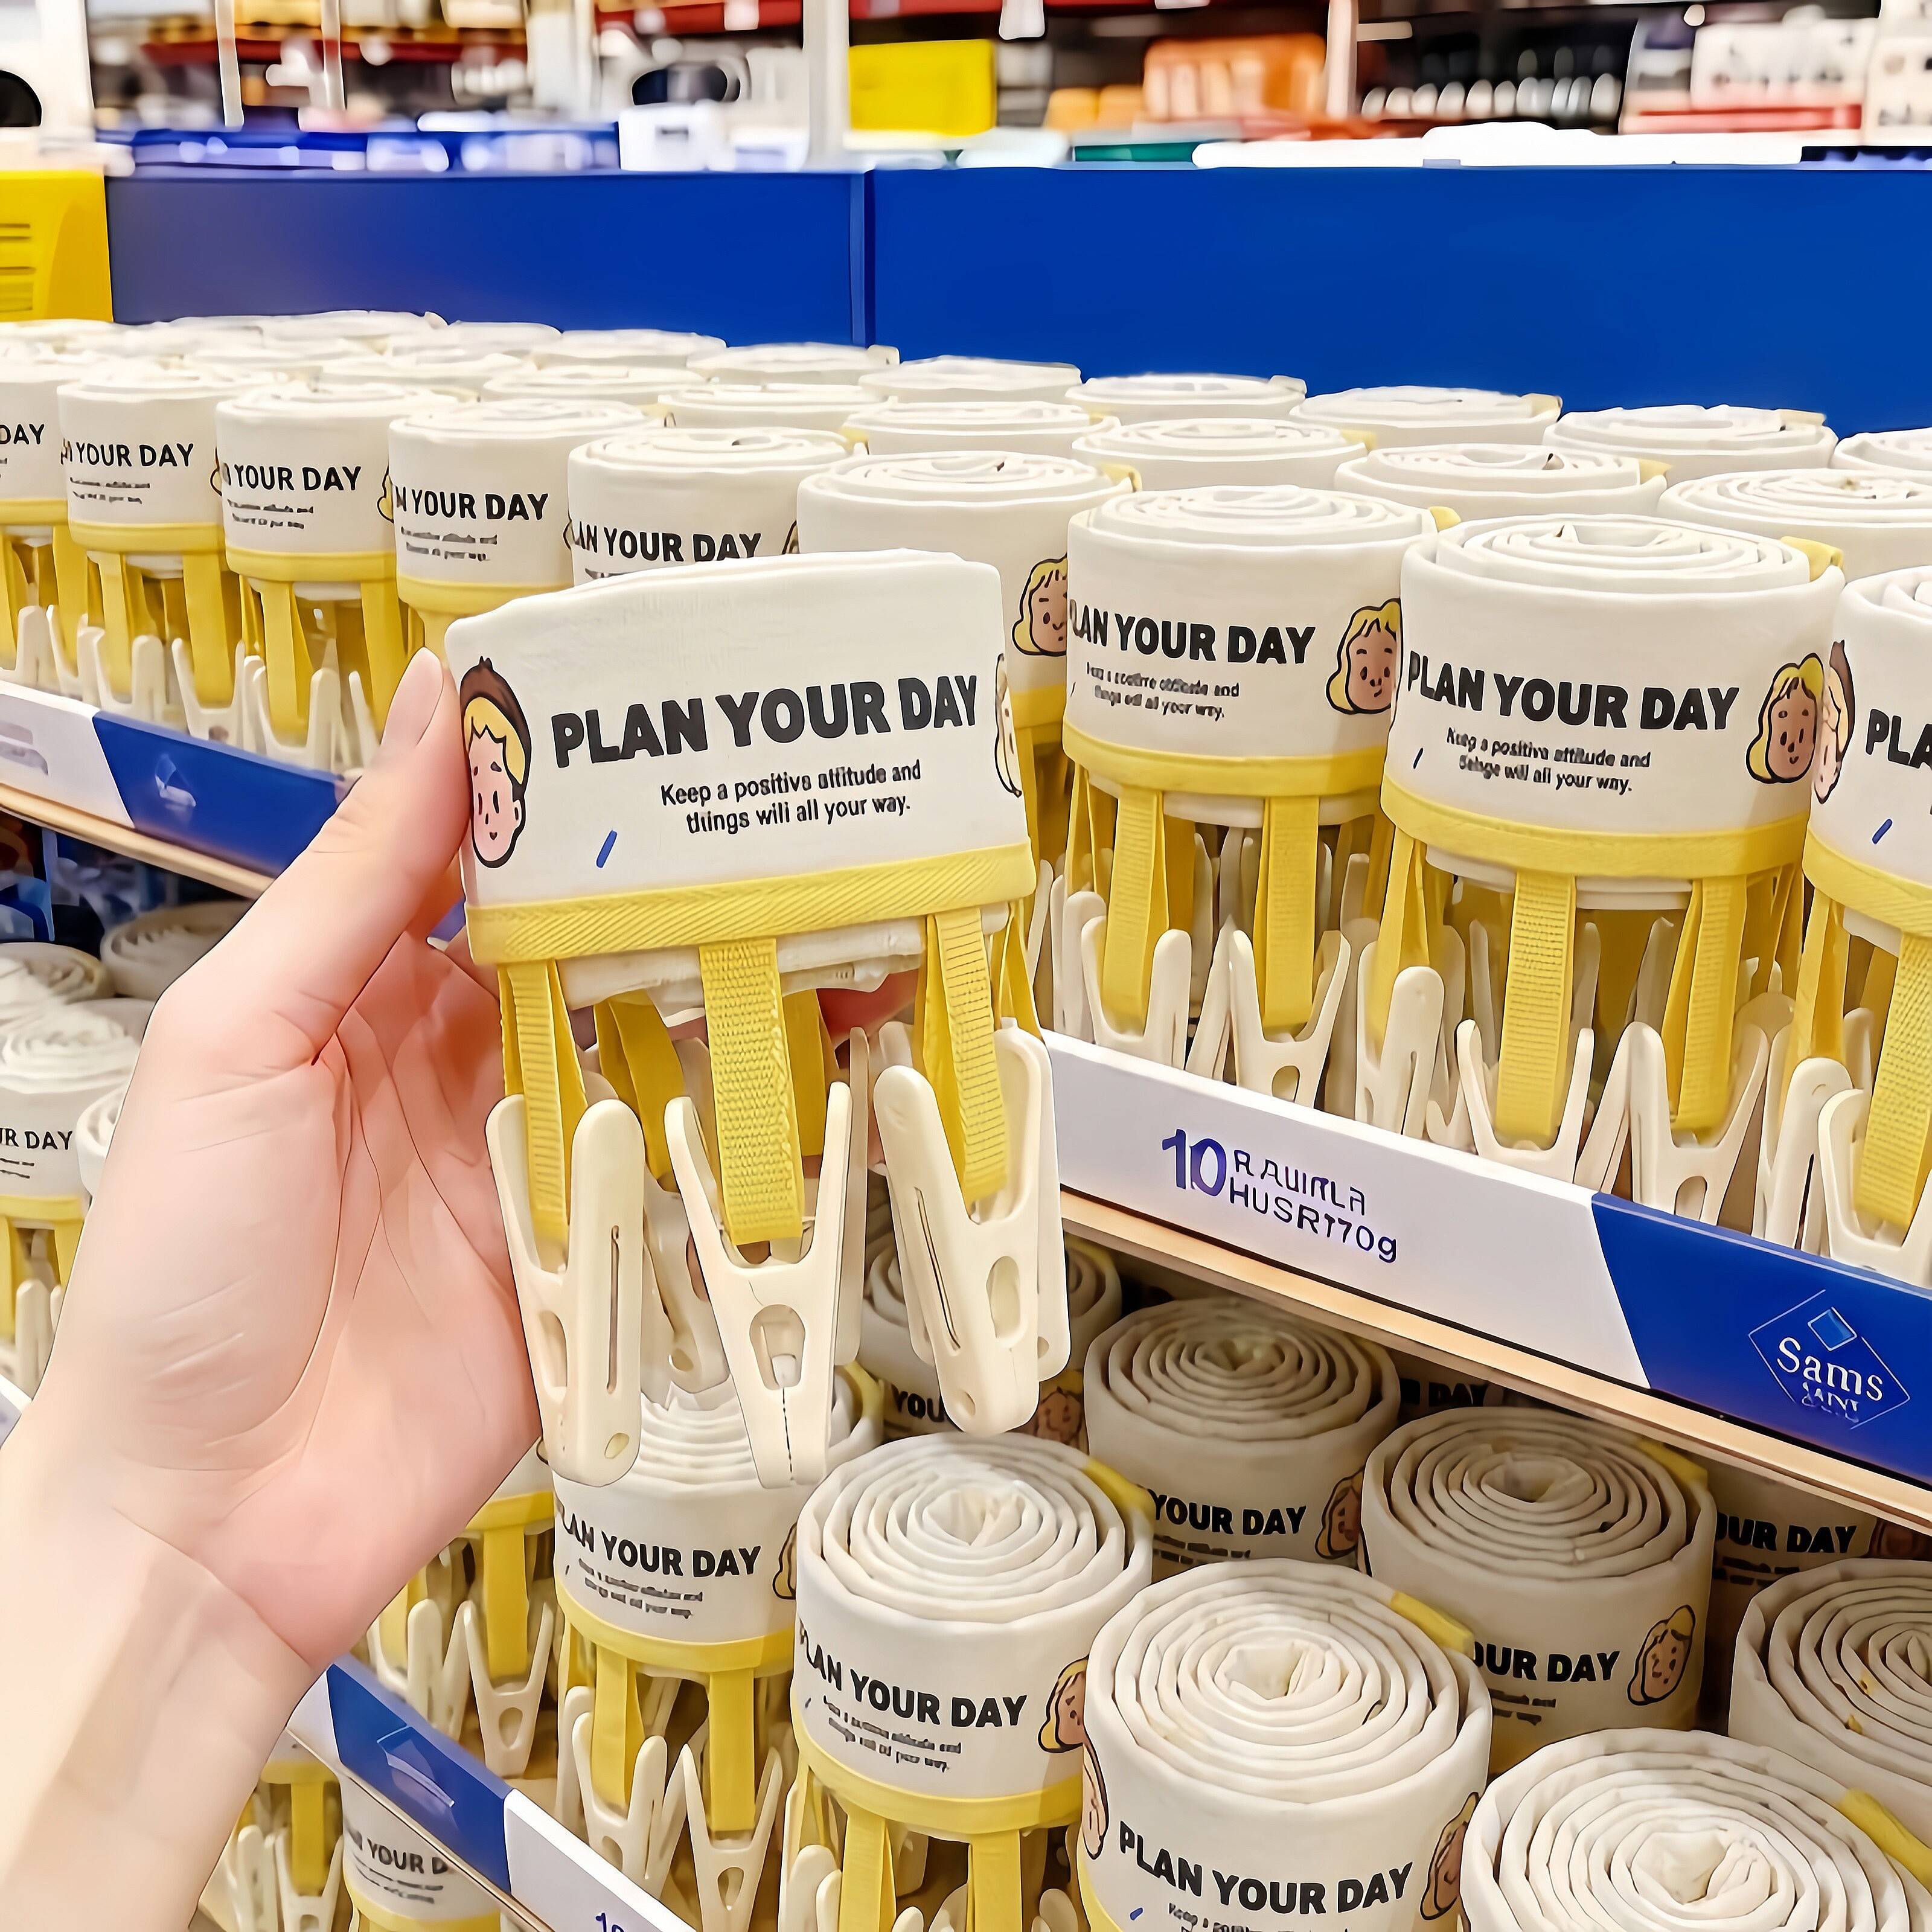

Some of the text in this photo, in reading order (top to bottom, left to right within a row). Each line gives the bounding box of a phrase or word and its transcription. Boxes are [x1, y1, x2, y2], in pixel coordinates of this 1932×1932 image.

[75, 442, 132, 467] YOUR
[139, 443, 194, 467] DAY
[234, 464, 295, 491] YOUR
[302, 465, 362, 491] DAY
[411, 488, 477, 519] YOUR
[485, 493, 549, 521] DAY
[603, 526, 684, 562] YOUR
[693, 533, 761, 563] DAY
[1114, 613, 1217, 662] YOUR
[1227, 625, 1316, 665] DAY
[1407, 650, 1740, 731] PLAN YOUR DAY
[551, 675, 977, 769] PLAN YOUR DAY
[1865, 708, 1932, 770] PLA
[661, 784, 711, 807] Keep
[717, 783, 728, 801] a
[892, 759, 921, 782] and
[796, 798, 819, 822] all
[824, 799, 868, 825] your
[872, 795, 911, 816] way.
[24, 1130, 73, 1150] DAY
[1162, 1128, 1227, 1197] 10
[891, 1384, 945, 1423] YOU
[1147, 1488, 1307, 1535] YOUR DAY
[601, 1531, 683, 1576] YOUR
[693, 1545, 761, 1578] DAY
[1786, 1524, 1857, 1553] DAY
[1547, 1651, 1620, 1683] DAY
[850, 1668, 941, 1726] YOUR
[951, 1694, 1028, 1728] DAY
[367, 1838, 424, 1874] YOUR
[1119, 1820, 1413, 1914] PLAN YOUR DAY
